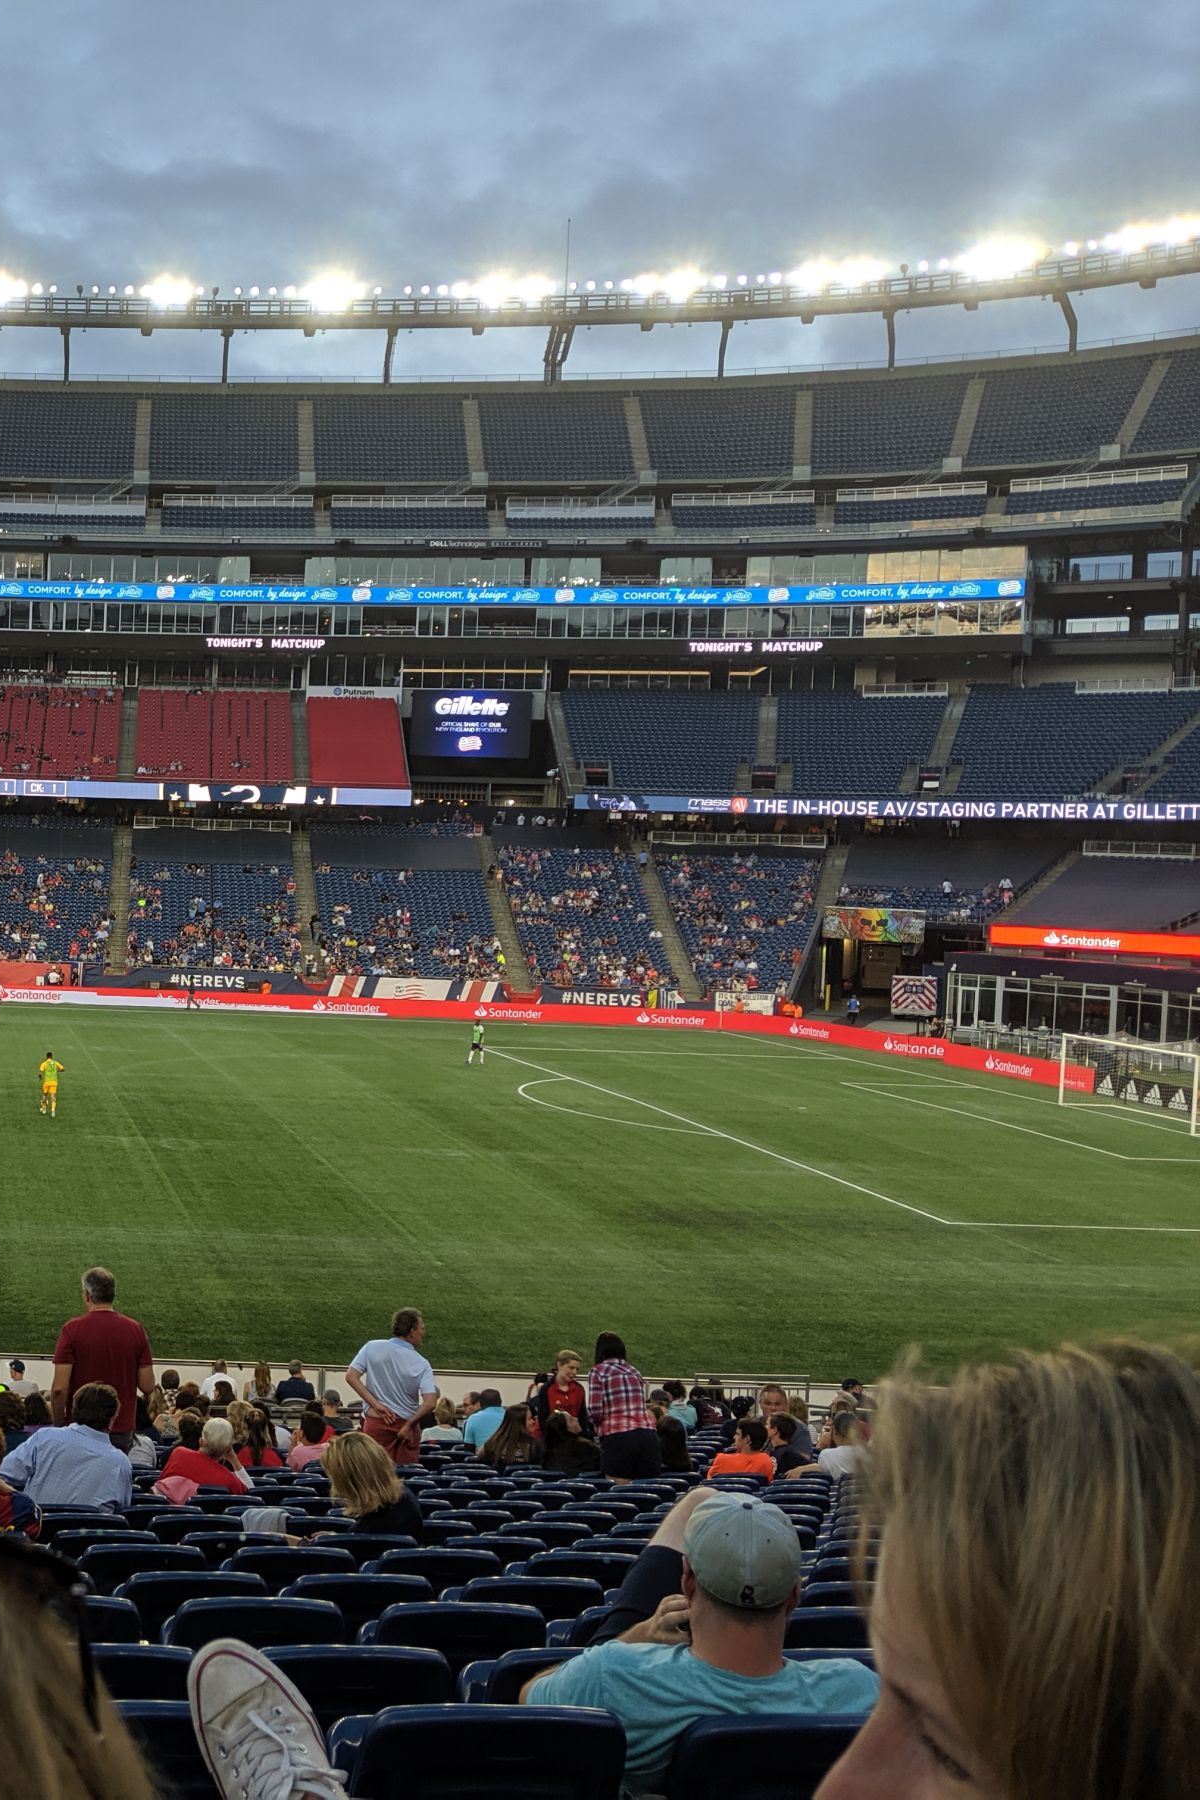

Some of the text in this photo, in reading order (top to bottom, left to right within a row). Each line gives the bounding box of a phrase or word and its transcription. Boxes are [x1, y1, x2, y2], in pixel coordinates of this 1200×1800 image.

[28, 585, 72, 595] COMFORT,
[74, 584, 84, 598] by
[220, 589, 264, 599] COMFORT,
[266, 587, 277, 601] by
[417, 591, 465, 601] COMFORT,
[466, 588, 477, 603] by
[623, 592, 672, 601] COMFORT,
[674, 589, 686, 604] by
[841, 588, 895, 599] COMFORT,
[896, 585, 909, 599] by
[206, 638, 325, 649] TONIGHT'S MATCHUP
[689, 641, 823, 652] TONIGHT'S MATCHUP
[434, 695, 510, 716] Gillette
[4, 782, 9, 791] 1
[30, 783, 57, 793] CK: 1
[753, 800, 1200, 820] THE IN-HOUSE AV/STAGING PARTNER AT GILLETT
[1061, 934, 1121, 947] Santander
[170, 974, 245, 989] #NEREVS
[10, 990, 62, 1001] Santander
[561, 992, 642, 1007] #NEREVS
[327, 1001, 380, 1013] Santander
[488, 1007, 543, 1019] Santander
[651, 1014, 706, 1026] Santander
[798, 1024, 830, 1039] Santander
[994, 1058, 1033, 1077] Santander
[1096, 1087, 1115, 1097] adidas
[1143, 1095, 1162, 1106] adidas
[1168, 1101, 1189, 1112] adidas
